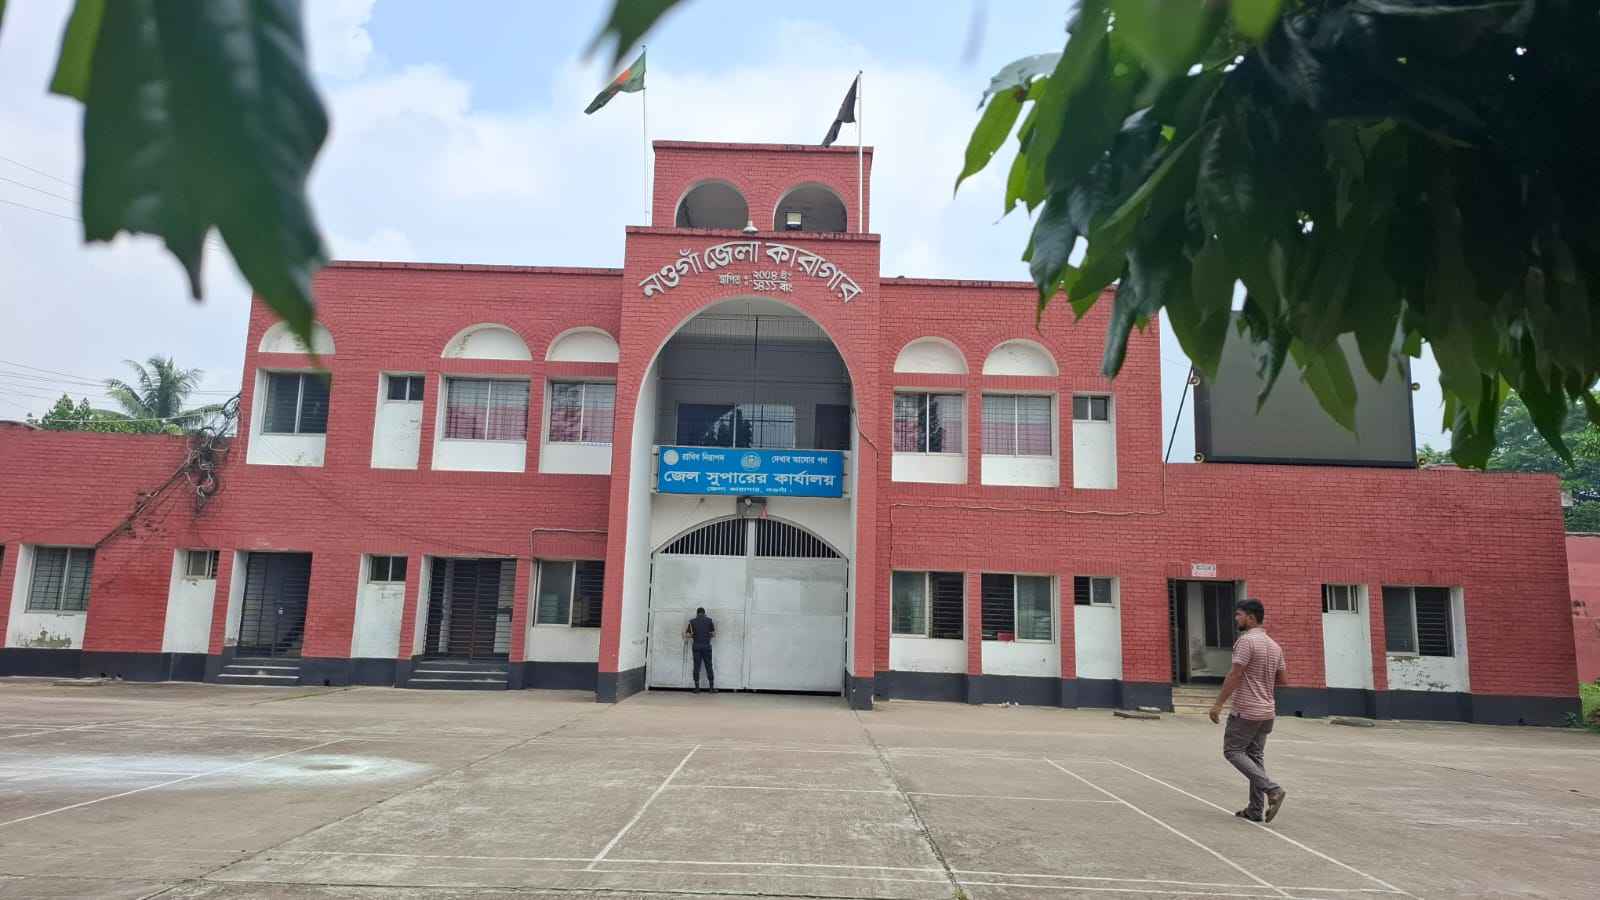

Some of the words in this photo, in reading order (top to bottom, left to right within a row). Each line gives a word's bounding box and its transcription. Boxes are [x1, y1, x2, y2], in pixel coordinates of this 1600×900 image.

[639, 247, 703, 297] নওগাঁ
[704, 241, 761, 270] জেলা
[766, 242, 863, 303] কারাগার
[664, 470, 700, 483] জেল
[706, 471, 768, 487] সুপারের
[774, 470, 836, 487] কার্যালয়
